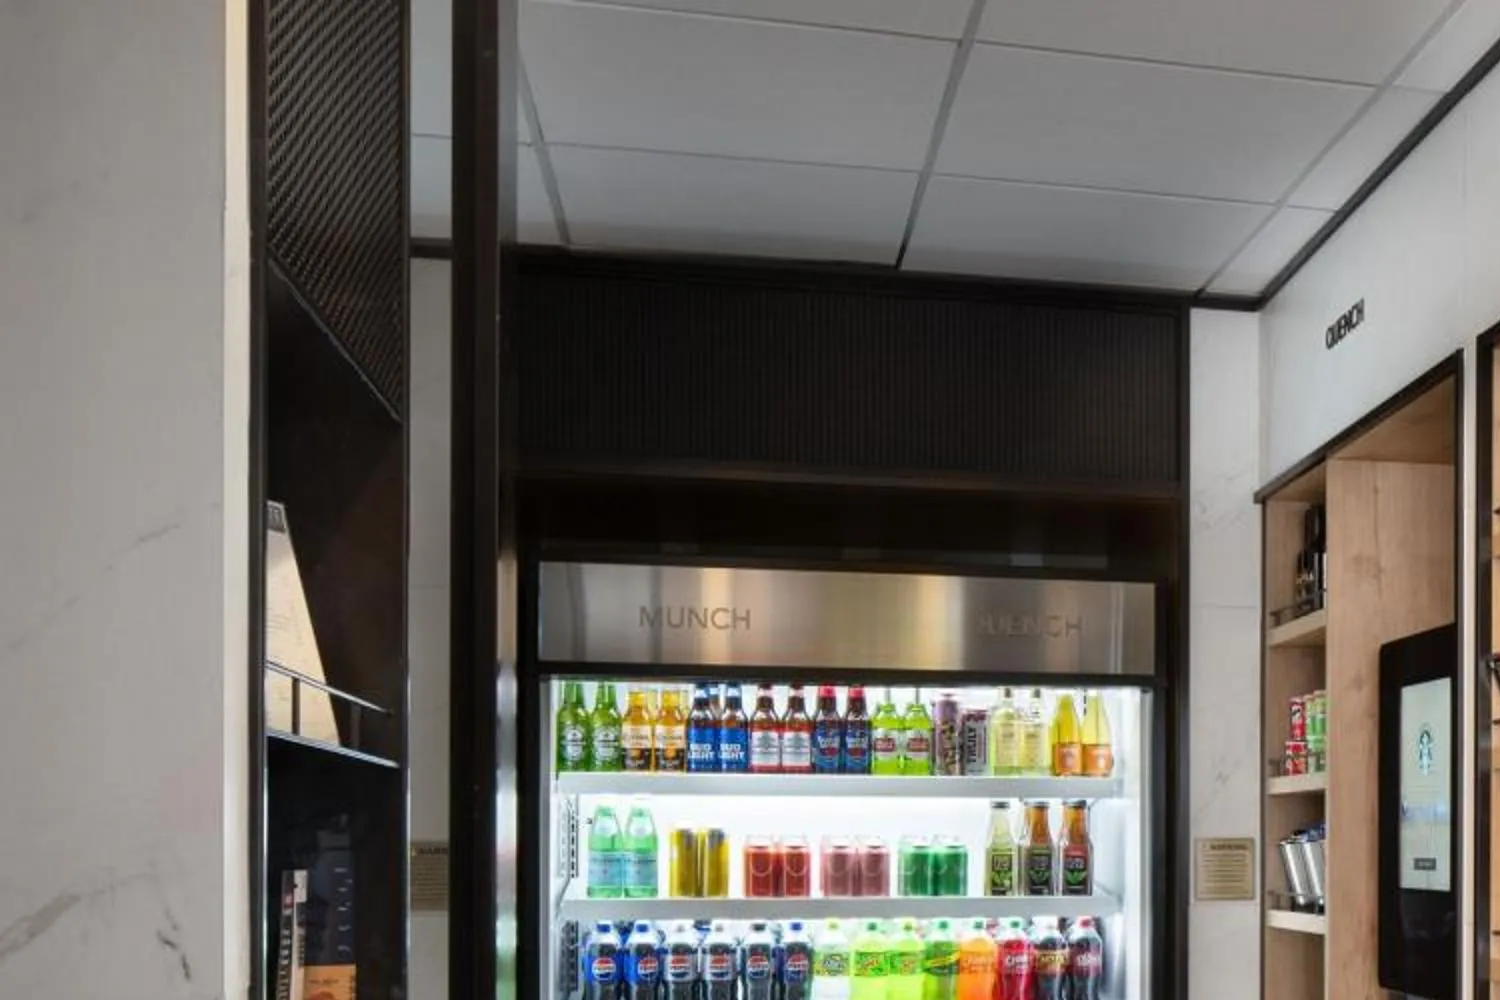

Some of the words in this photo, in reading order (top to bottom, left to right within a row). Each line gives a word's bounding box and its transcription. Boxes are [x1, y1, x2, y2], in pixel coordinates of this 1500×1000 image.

[1325, 297, 1365, 350] QUENCH
[639, 605, 751, 630] MUNCH
[967, 727, 977, 764] TRULY
